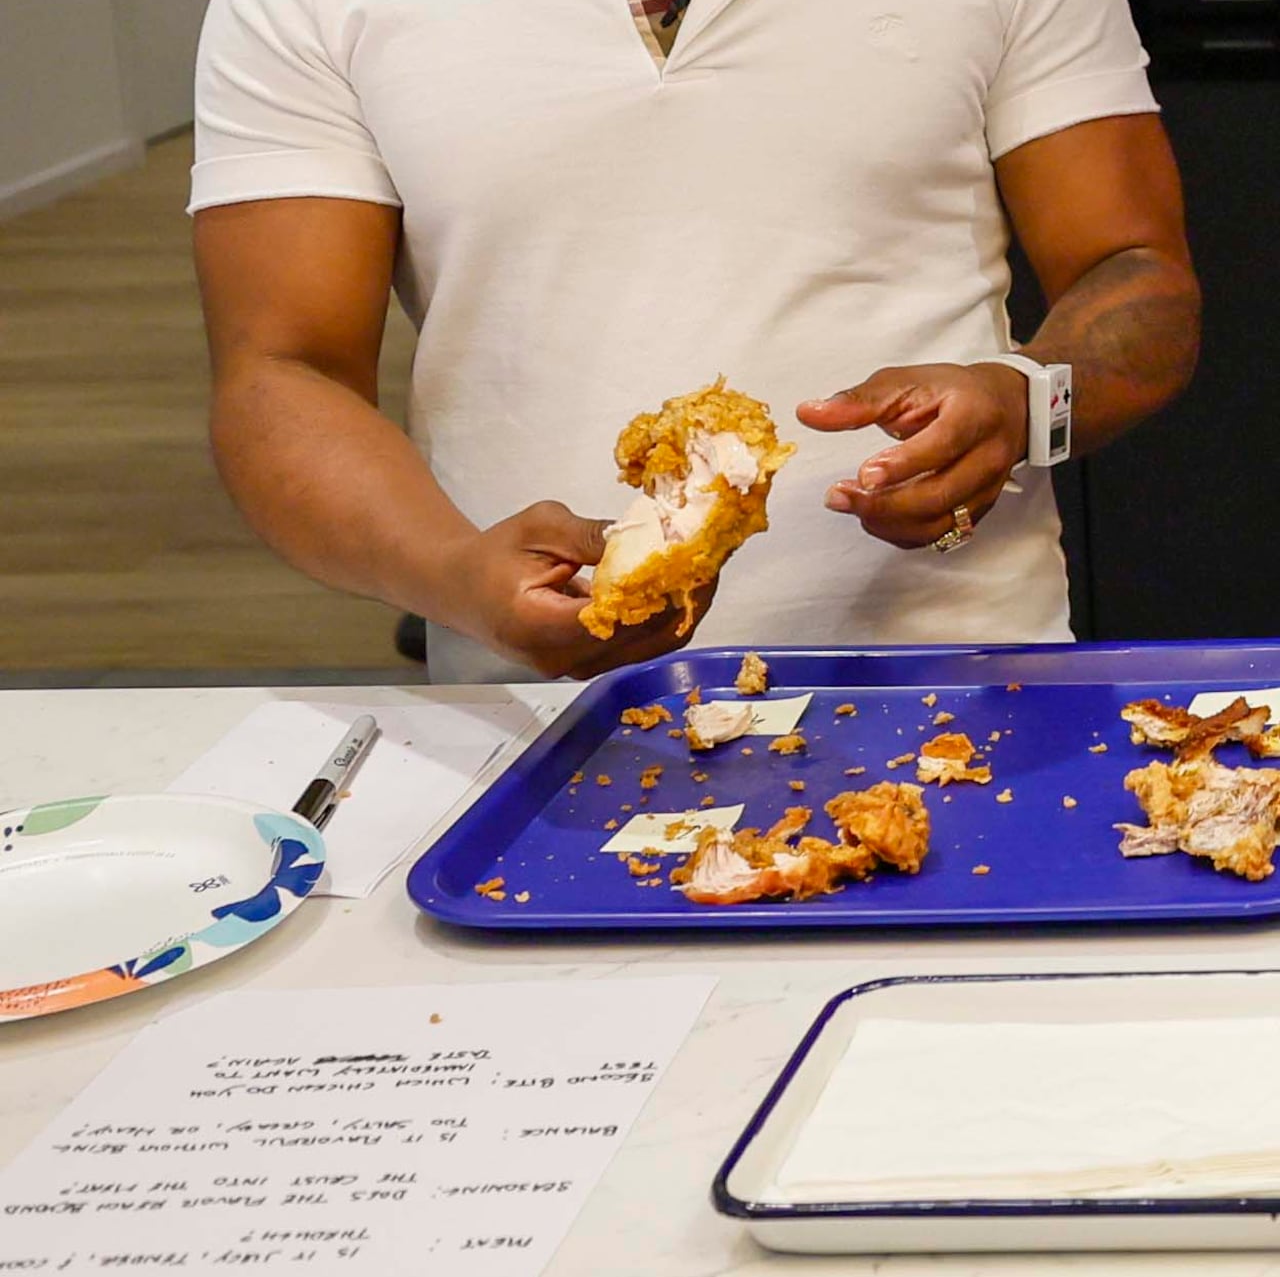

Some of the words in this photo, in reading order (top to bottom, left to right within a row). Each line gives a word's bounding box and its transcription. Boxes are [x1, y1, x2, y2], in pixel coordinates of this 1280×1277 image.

[599, 1061, 658, 1070] TEST
[215, 1071, 243, 1079] TO
[252, 1069, 320, 1079] WANT
[567, 1071, 654, 1085] SECOND
[288, 1082, 375, 1093] CHICKEN
[395, 1077, 470, 1088] WHICH
[190, 1085, 247, 1098] YOU
[246, 1085, 279, 1095] DO
[431, 1117, 468, 1128] TOO
[169, 1126, 200, 1135] OR
[252, 1135, 382, 1147] FLAVORFUL
[401, 1134, 423, 1143] IT
[439, 1132, 457, 1143] IS
[137, 1142, 228, 1152] WITHOUT
[213, 1177, 268, 1187] INTO
[290, 1174, 358, 1186] CRUST
[376, 1173, 417, 1184] THE
[148, 1182, 187, 1193] THE
[281, 1193, 328, 1206] THE
[350, 1189, 407, 1201] DOES
[97, 1200, 167, 1212] REACH
[181, 1196, 266, 1209] FLAVOR
[292, 1251, 316, 1261] IT
[338, 1247, 360, 1259] IS
